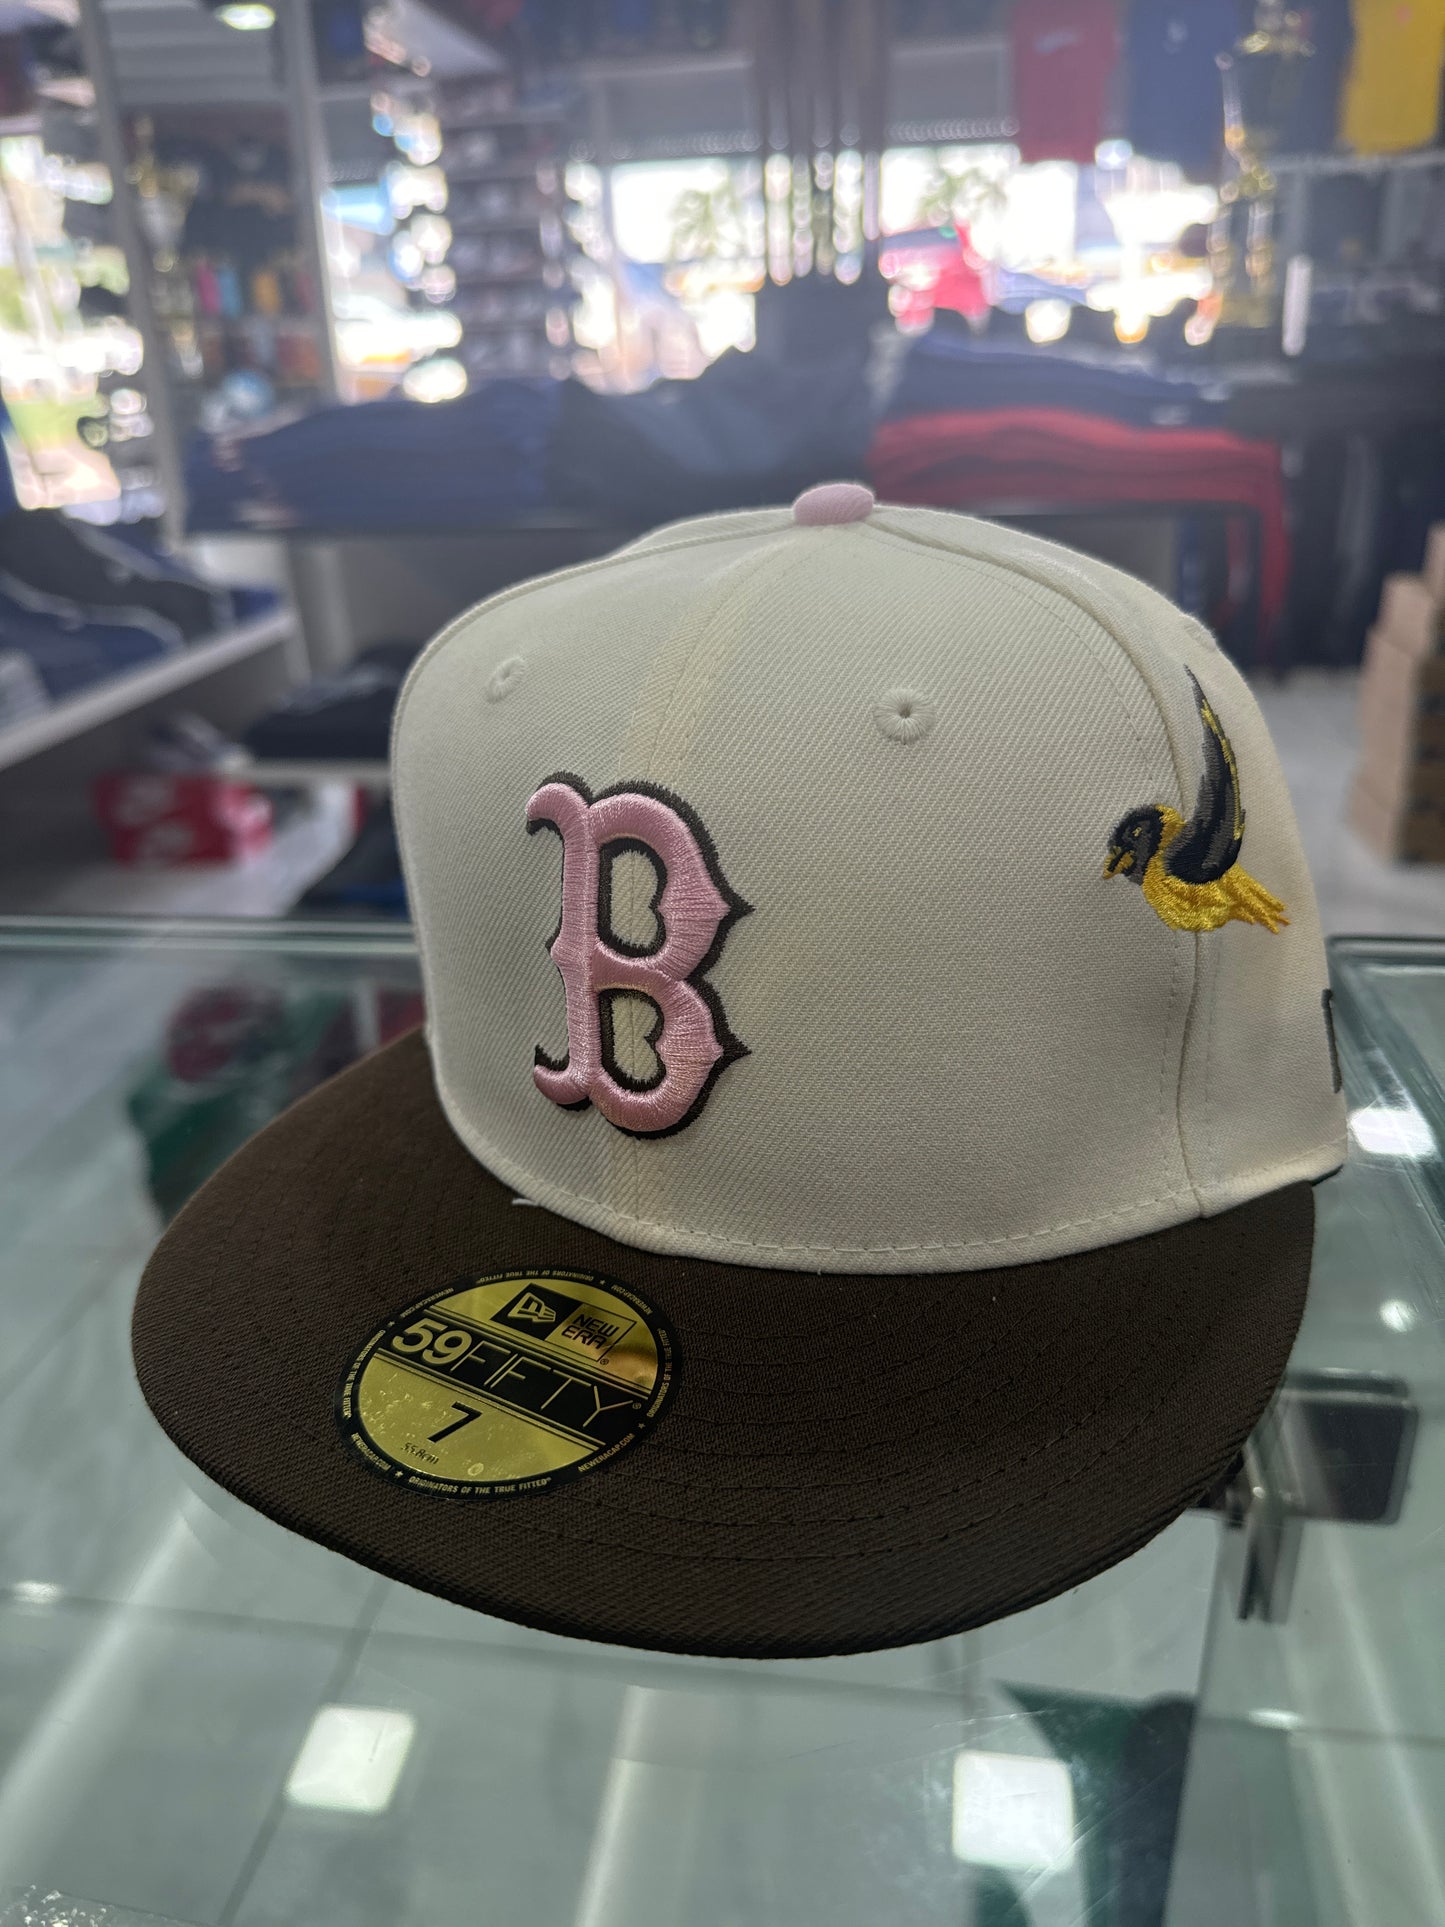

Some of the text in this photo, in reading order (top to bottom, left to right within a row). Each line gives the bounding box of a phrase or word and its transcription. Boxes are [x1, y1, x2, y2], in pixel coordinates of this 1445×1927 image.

[525, 770, 756, 1140] B
[505, 1270, 522, 1278] TRUE
[561, 1325, 607, 1350] ERA
[572, 1313, 620, 1337] NEW
[391, 1317, 634, 1428] 59FIFTY
[427, 1401, 483, 1443] 7
[578, 1433, 635, 1472] NEWERACAP.COM
[408, 1476, 459, 1493] ORIGINATORS
[461, 1486, 472, 1494] OF
[475, 1486, 491, 1494] THE
[494, 1484, 516, 1493] TRUE
